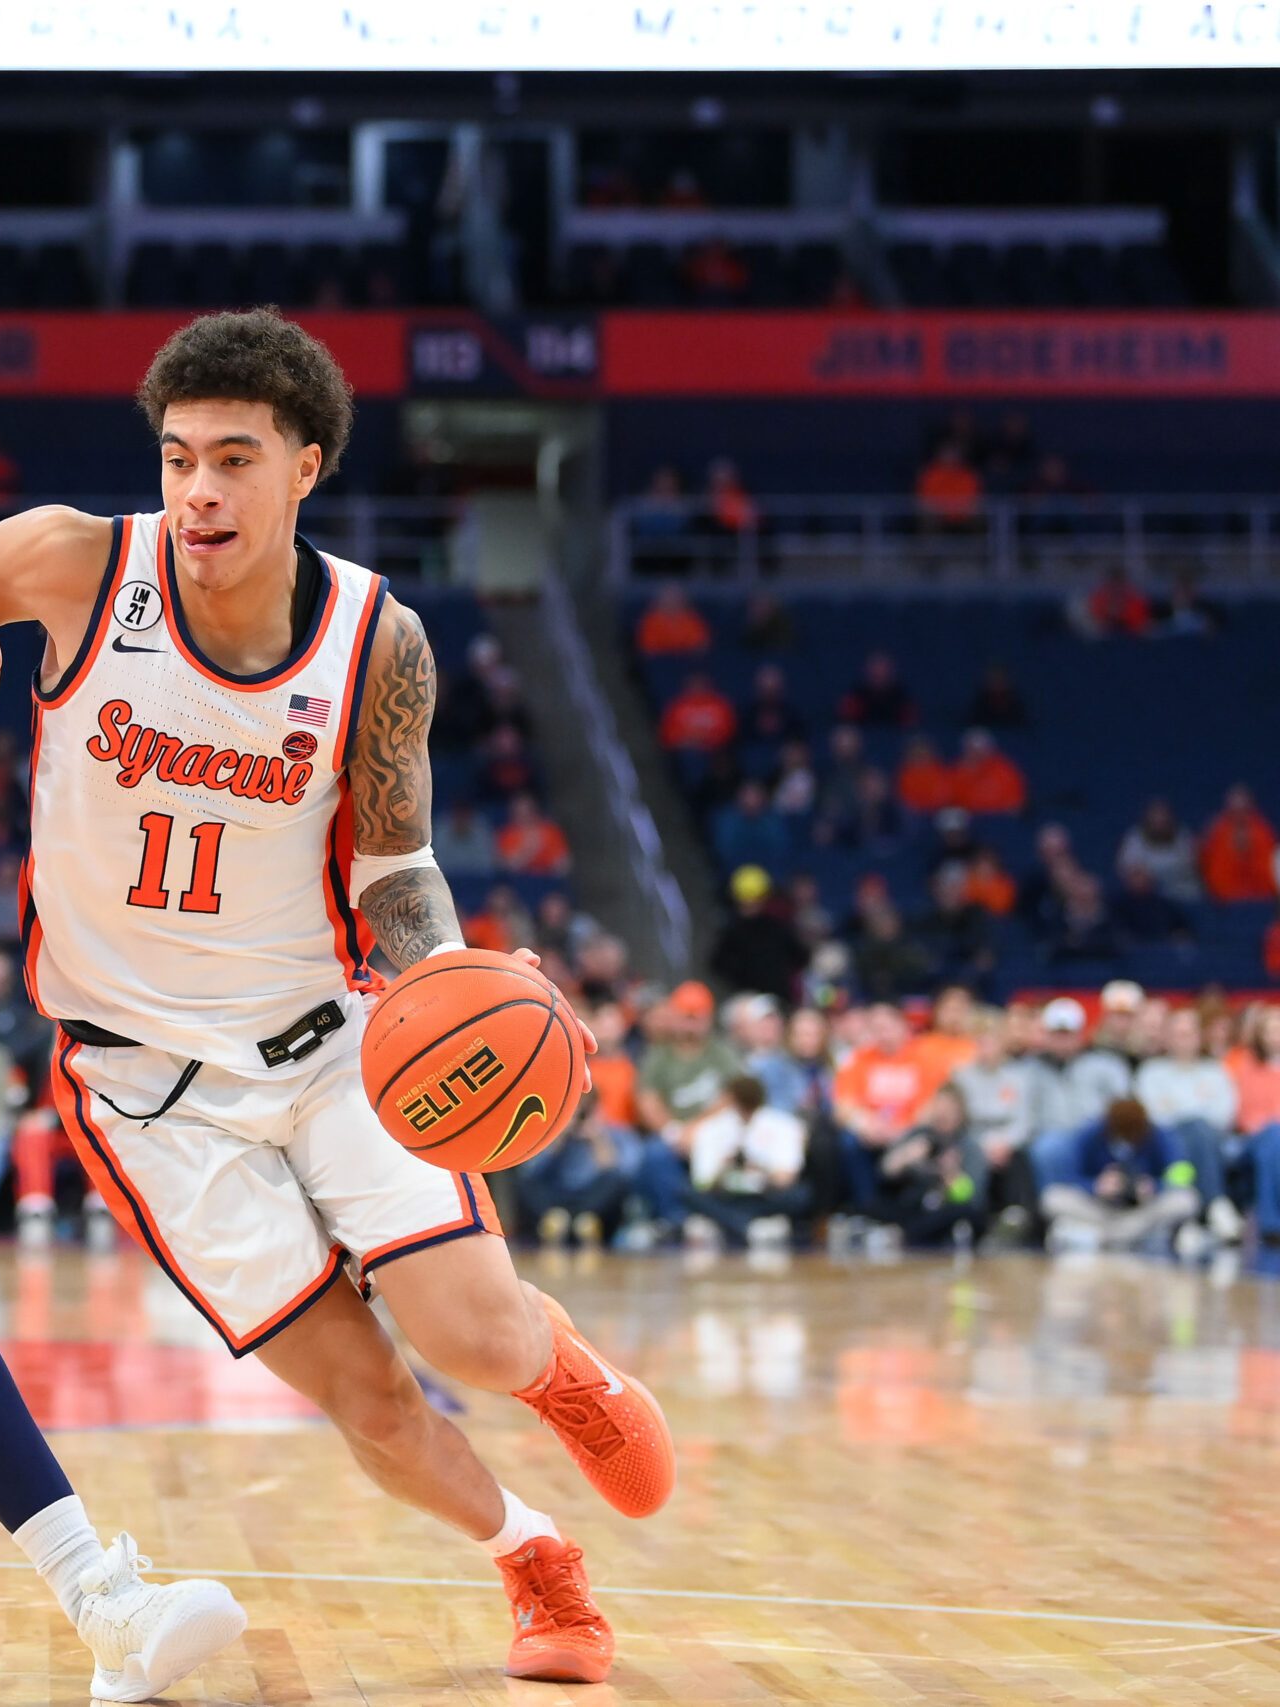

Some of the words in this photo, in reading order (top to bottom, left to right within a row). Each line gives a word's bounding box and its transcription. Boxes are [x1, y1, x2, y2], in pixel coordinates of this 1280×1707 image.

[124, 602, 145, 625] 21
[132, 586, 151, 605] LM
[86, 699, 313, 805] Syracuse
[126, 810, 226, 914] 11
[315, 1012, 331, 1028] 46
[395, 1036, 485, 1107] CHAMPIONSHIP
[401, 1045, 506, 1134] ELITE
